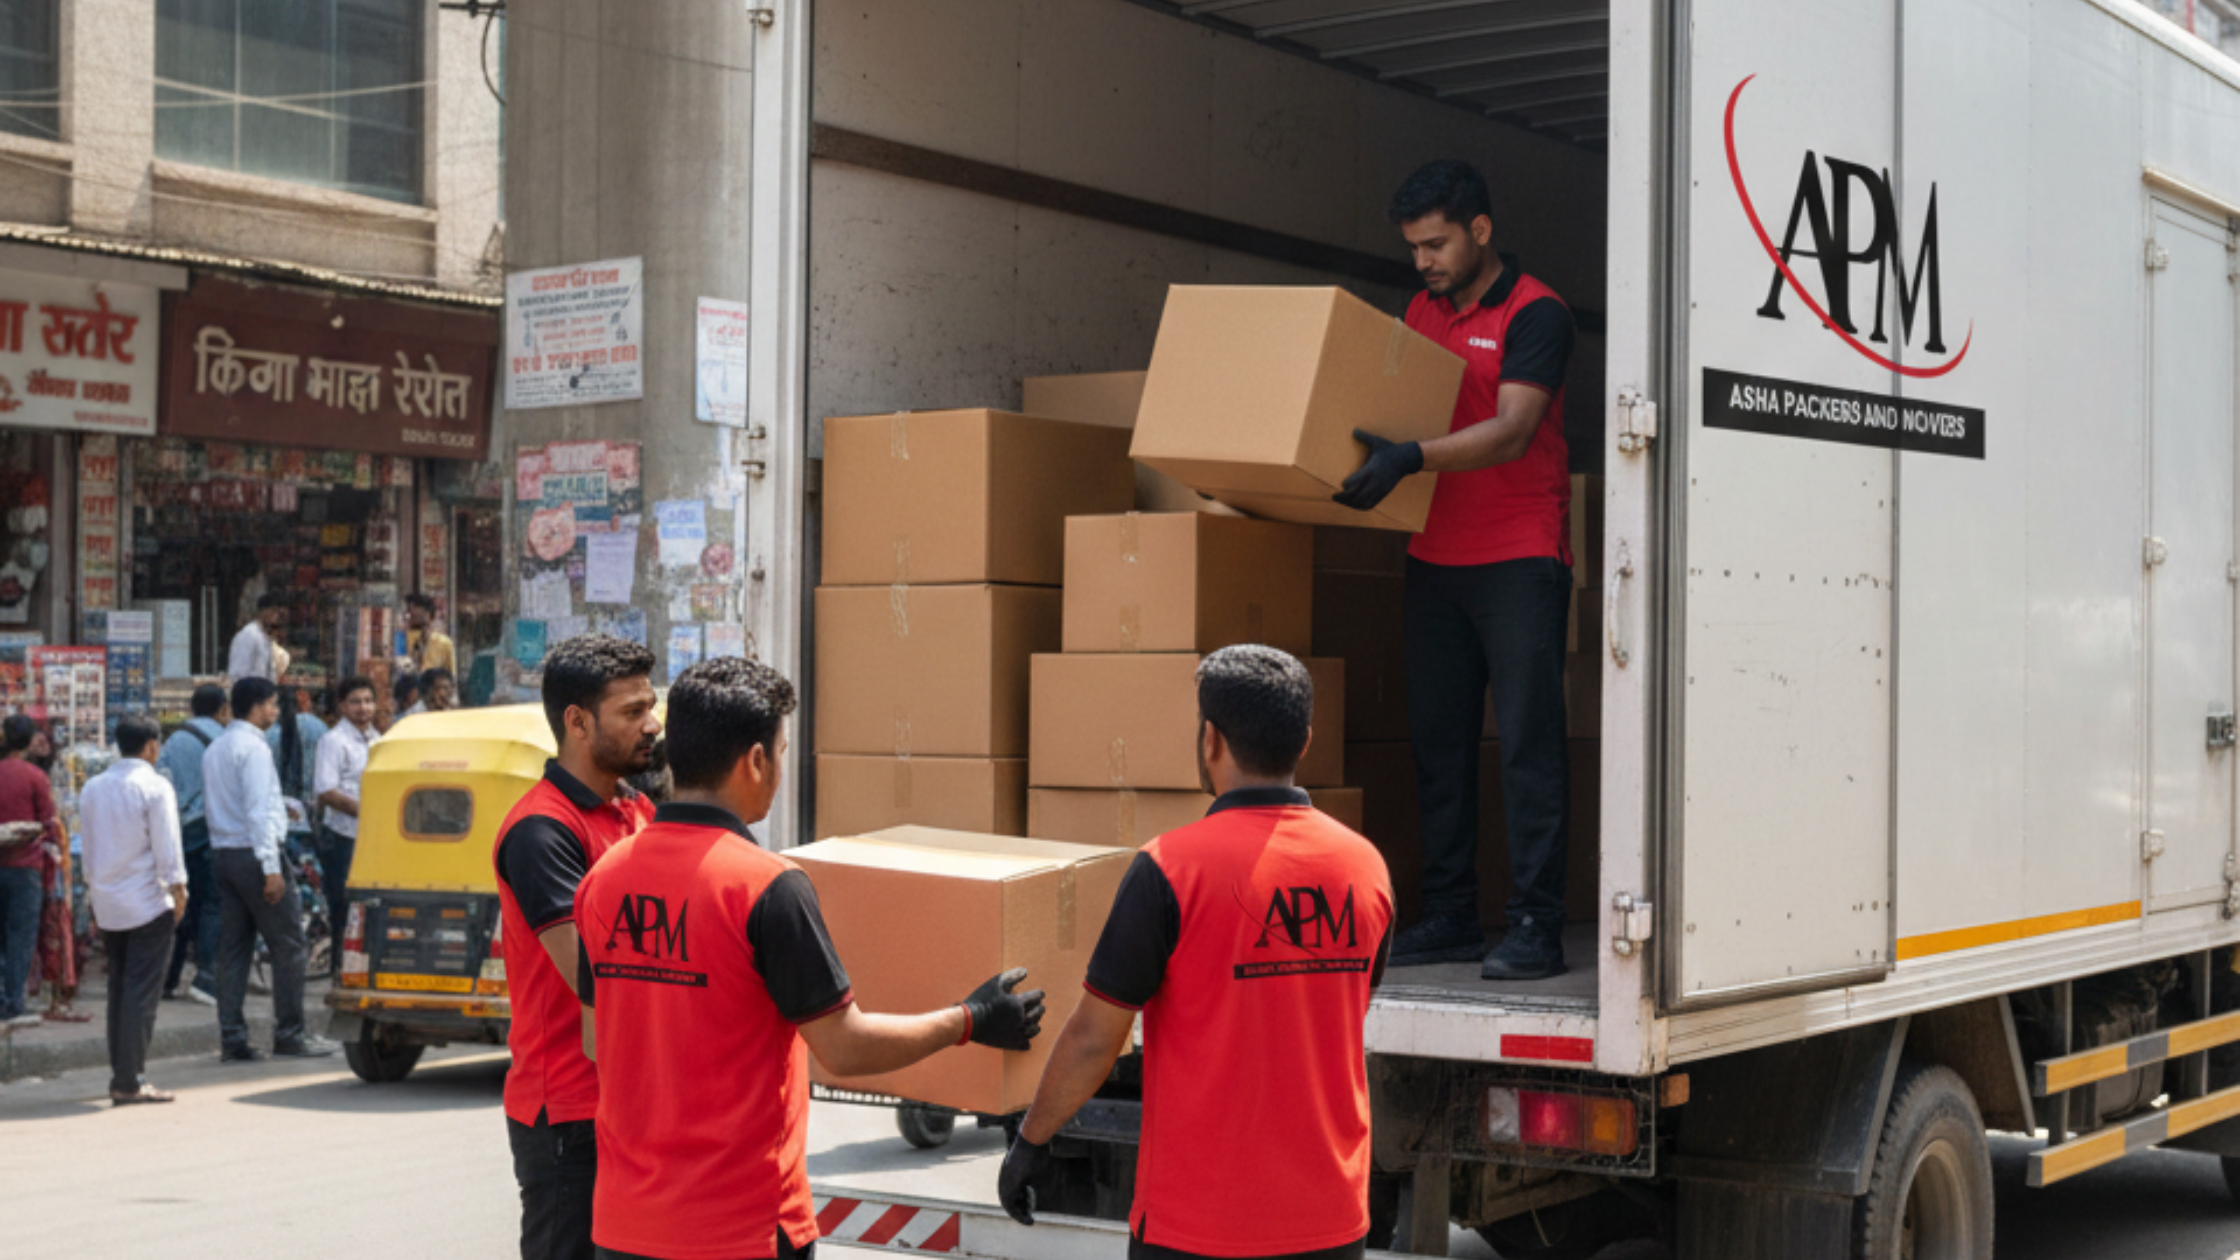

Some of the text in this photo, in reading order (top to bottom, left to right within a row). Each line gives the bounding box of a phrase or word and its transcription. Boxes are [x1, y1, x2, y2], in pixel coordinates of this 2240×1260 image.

[1757, 149, 1946, 353] APM
[1729, 382, 1779, 414] ASHA
[1864, 402, 1898, 430] AND
[605, 893, 689, 962] APM
[1254, 884, 1357, 948] APM
